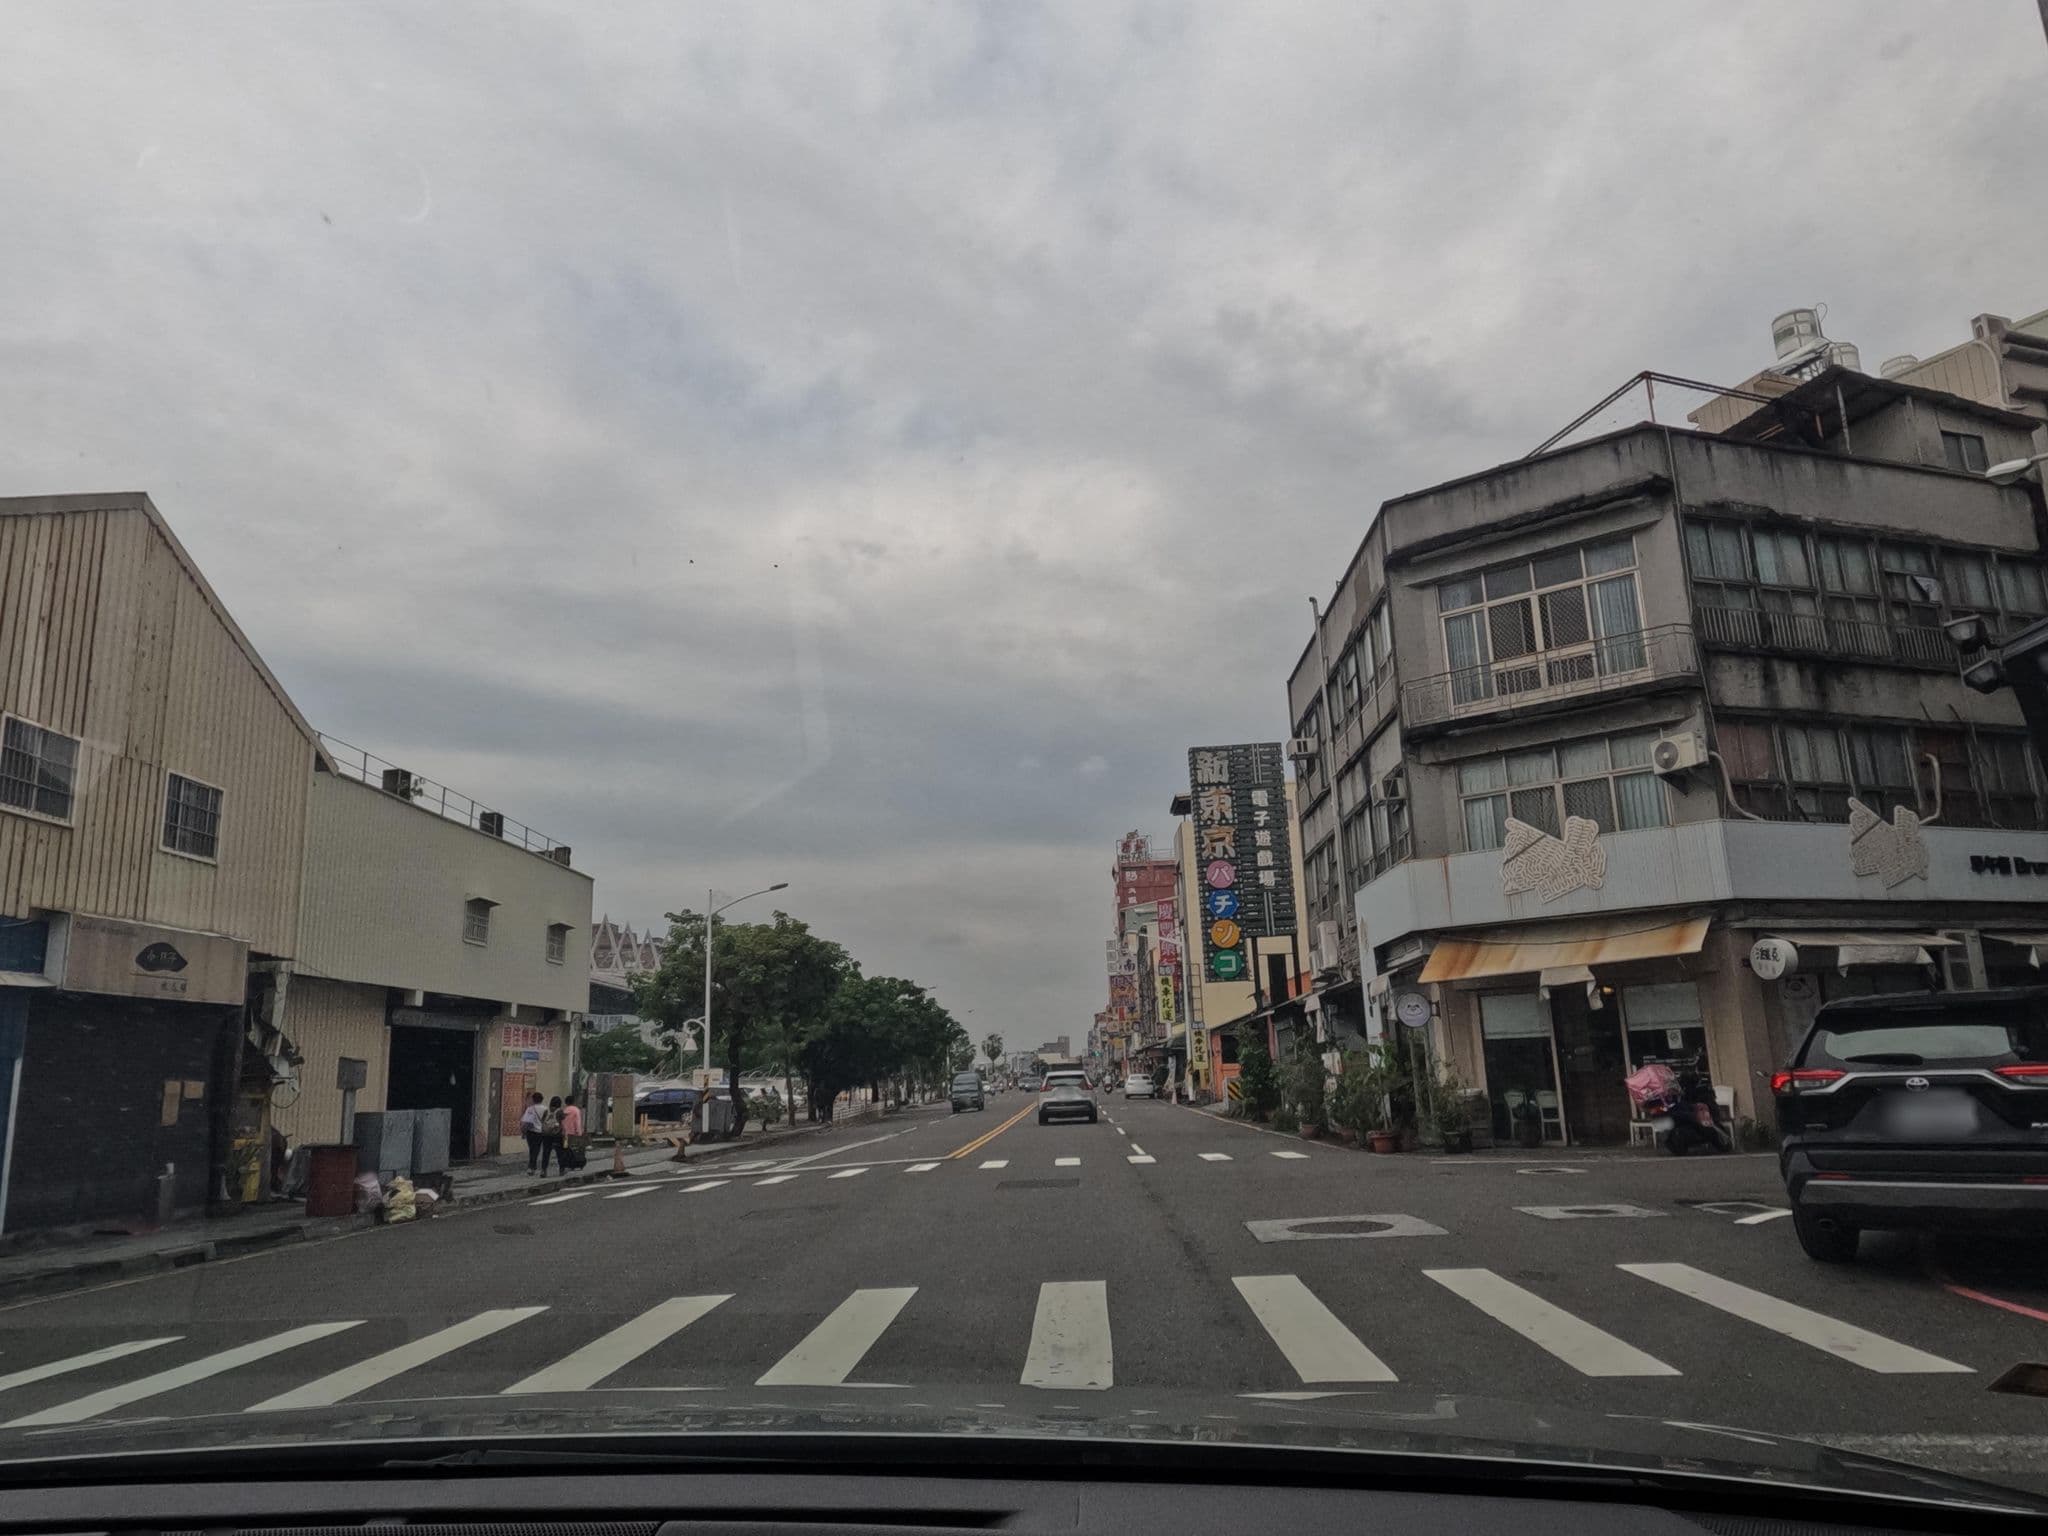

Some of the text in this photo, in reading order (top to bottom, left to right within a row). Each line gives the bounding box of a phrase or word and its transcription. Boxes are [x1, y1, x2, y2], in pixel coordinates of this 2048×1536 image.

[1251, 790, 1275, 888] 電子遊戲場
